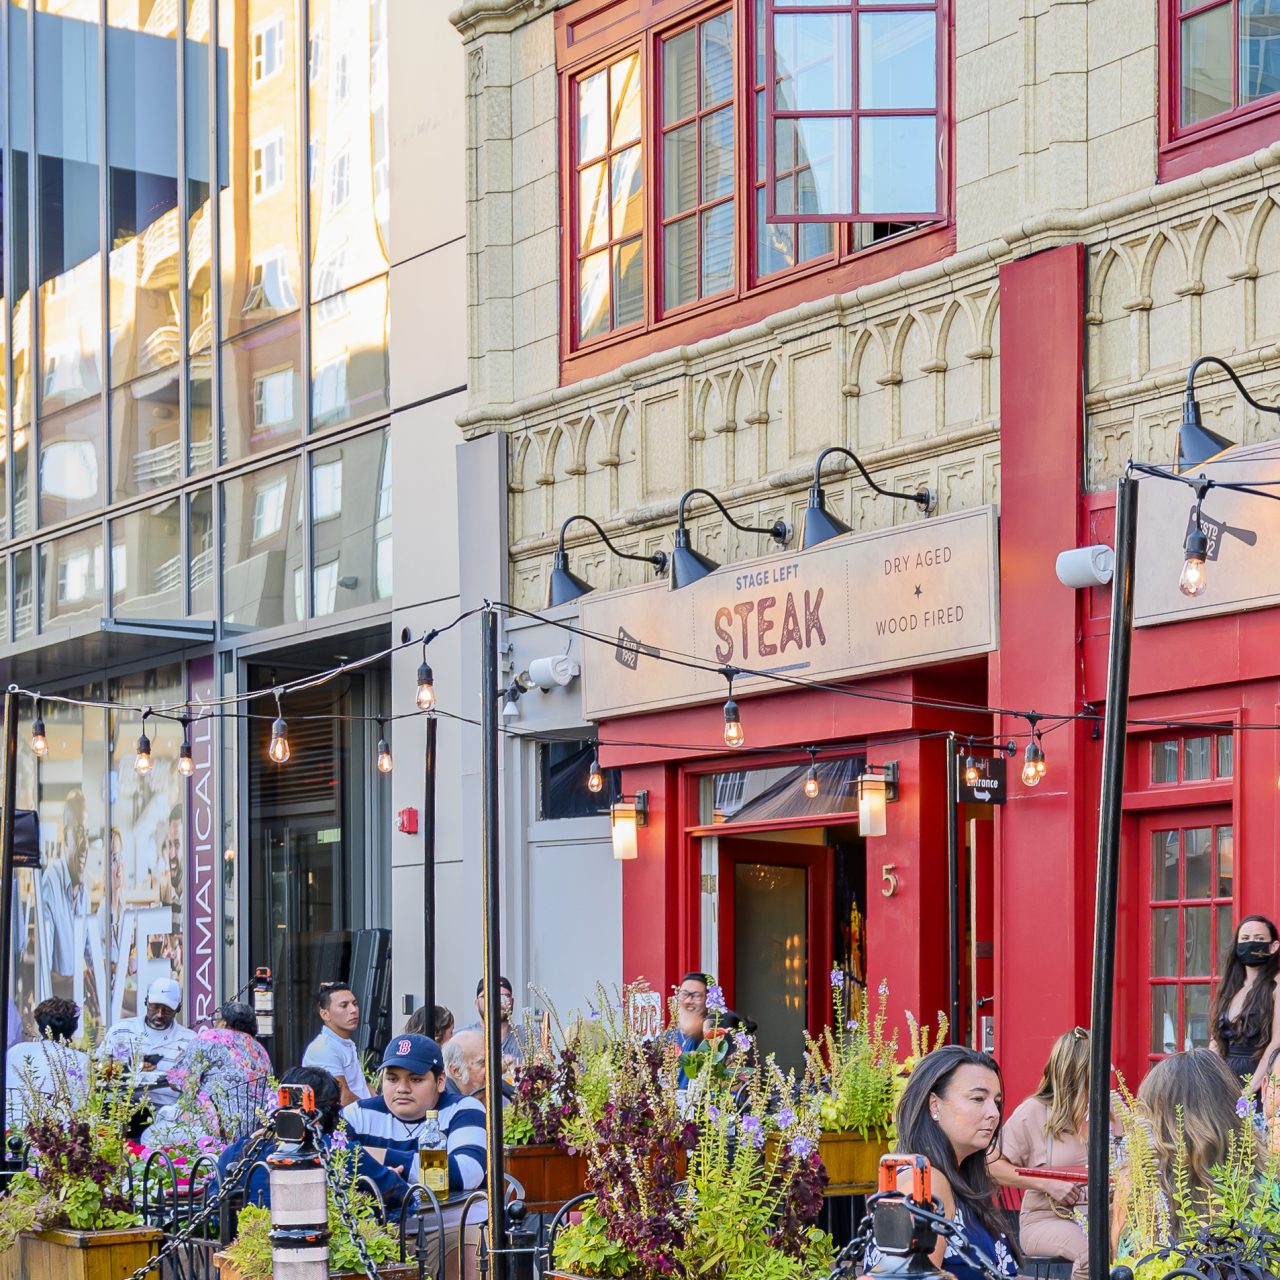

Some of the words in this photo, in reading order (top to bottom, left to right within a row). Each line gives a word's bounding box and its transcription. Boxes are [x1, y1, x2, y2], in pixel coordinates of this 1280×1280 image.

[1200, 519, 1218, 540] STD
[884, 557, 910, 576] DRY
[915, 547, 952, 567] AGED
[736, 571, 769, 590] STAGE
[773, 564, 799, 584] LEFT
[714, 587, 826, 665] STEAK
[876, 612, 918, 636] WOOD
[924, 605, 965, 628] FIRED
[881, 863, 897, 897] 5
[396, 1039, 411, 1055] B
